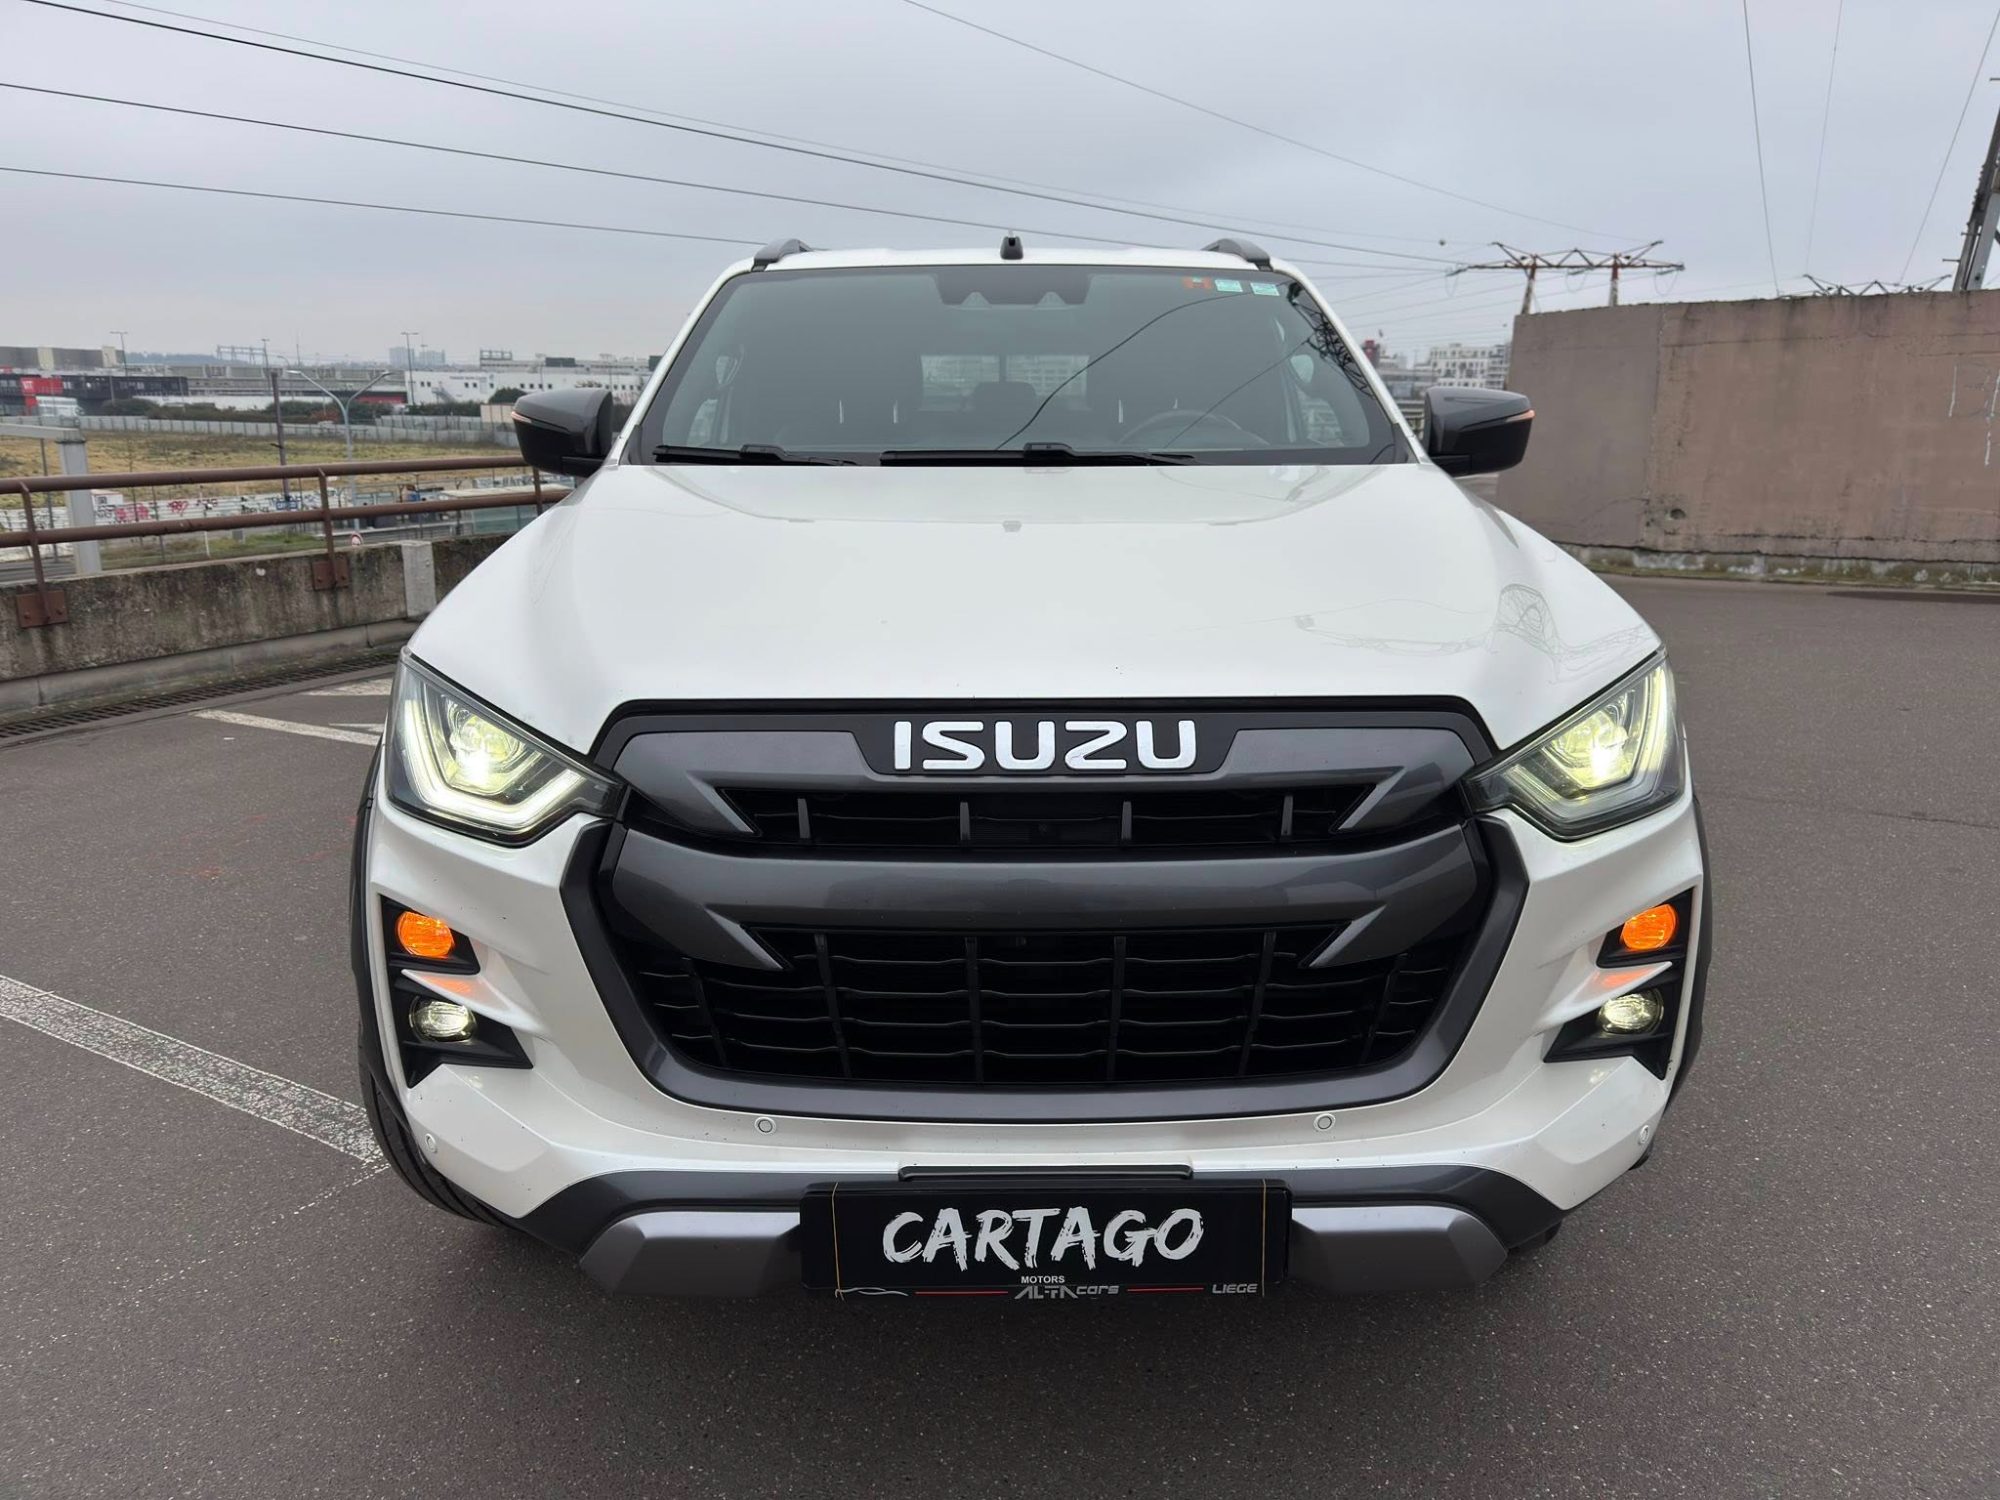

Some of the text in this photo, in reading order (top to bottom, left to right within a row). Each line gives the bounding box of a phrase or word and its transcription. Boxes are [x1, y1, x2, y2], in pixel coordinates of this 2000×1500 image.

[894, 720, 1197, 770] ISUZU
[883, 1206, 1204, 1272] CARTAGO
[1021, 1275, 1066, 1284] MOTORS
[1212, 1283, 1258, 1295] LIEGE
